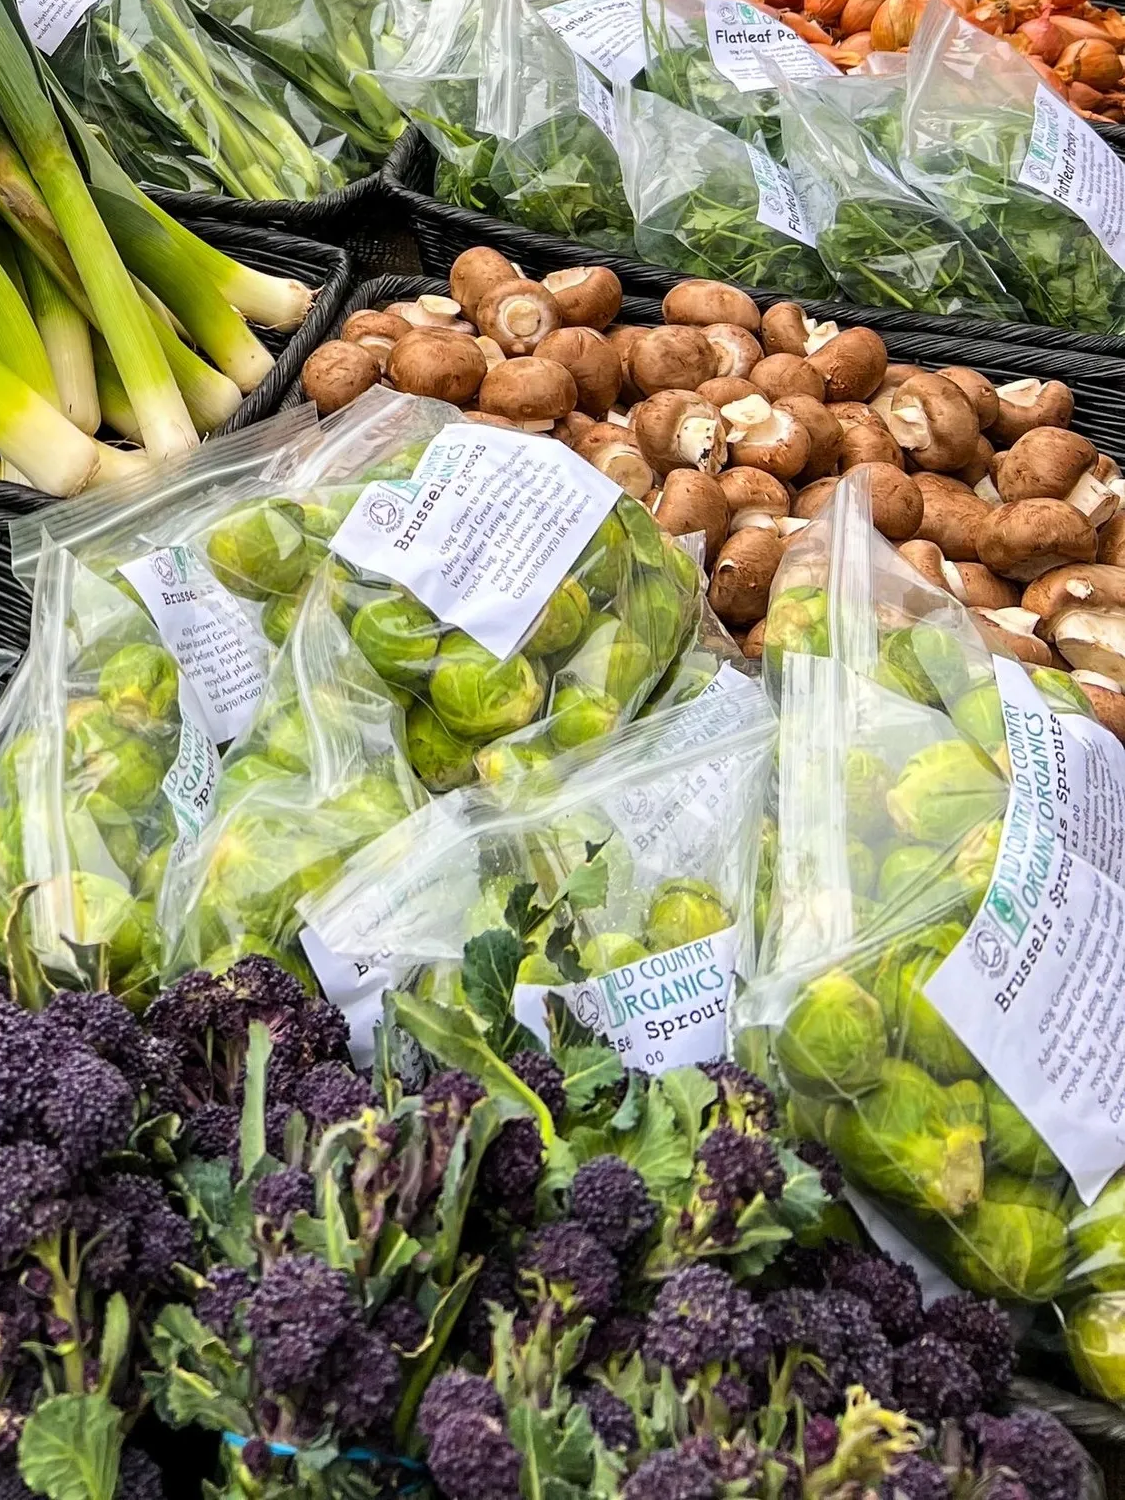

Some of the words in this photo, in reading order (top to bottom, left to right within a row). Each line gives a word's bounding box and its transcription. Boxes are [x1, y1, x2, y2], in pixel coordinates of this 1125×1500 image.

[715, 29, 772, 44] Flatleaf
[1052, 157, 1075, 200] Flatleaf
[783, 187, 801, 231] Flatleaf
[419, 442, 445, 479] OUNTRY
[450, 504, 473, 534] Grown
[468, 493, 481, 506] to
[439, 548, 463, 579] Adrian
[458, 523, 478, 551] Izzard
[473, 499, 494, 526] Great
[450, 562, 470, 589] Wash
[465, 537, 487, 565] before
[482, 507, 509, 539] Eating.
[459, 571, 487, 602] recycle
[478, 551, 499, 572] bag.
[494, 508, 527, 550] Polythene
[488, 548, 517, 585] recycled
[512, 518, 536, 552] plastic,
[531, 497, 552, 522] widely
[499, 574, 515, 594] Soil
[510, 530, 546, 575] Association
[540, 504, 564, 533] Organic
[512, 536, 561, 600] G2470/AG02470
[555, 523, 569, 538] UK
[160, 587, 198, 606] Brusse
[191, 618, 217, 635] Grown
[192, 647, 216, 663] before
[220, 670, 262, 697] Associatio
[1004, 701, 1027, 766] COUNTRY
[1025, 715, 1053, 815] ORGANICS
[1050, 716, 1069, 800] Sprouts
[635, 774, 706, 850] Brussels
[1068, 805, 1081, 846] £3.00
[1082, 797, 1091, 840] certified
[993, 916, 1053, 1010] Brussels
[1046, 855, 1073, 908] Sprou
[1052, 917, 1076, 956] £3.00
[638, 937, 716, 982] COUNTRY
[643, 995, 727, 1045] Sprout
[1046, 1053, 1070, 1085] Wash
[1065, 1021, 1088, 1054] before
[1059, 1064, 1086, 1103] recycle
[1096, 1084, 1114, 1109] Soil
